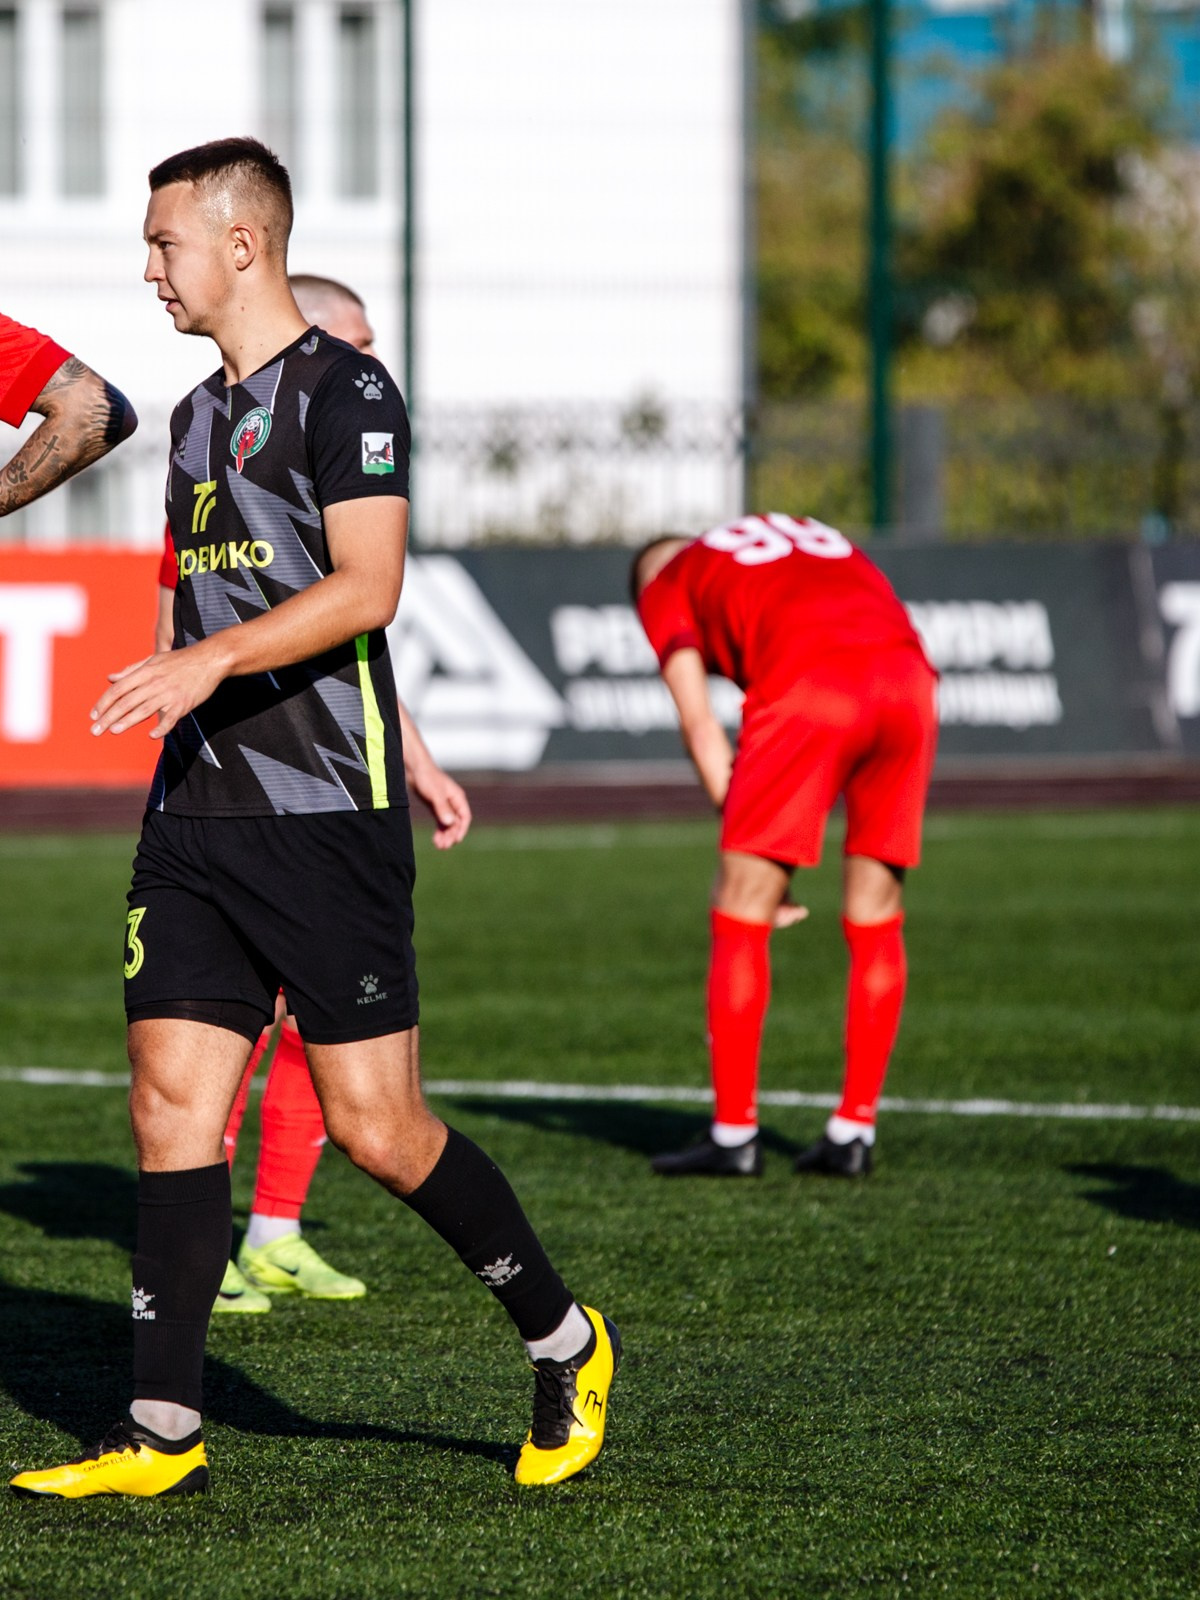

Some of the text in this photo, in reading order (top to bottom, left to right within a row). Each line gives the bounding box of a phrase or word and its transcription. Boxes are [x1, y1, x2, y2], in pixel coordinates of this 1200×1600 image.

[174, 540, 275, 580] рвико
[123, 906, 147, 980] 3
[356, 992, 388, 1005] KELME
